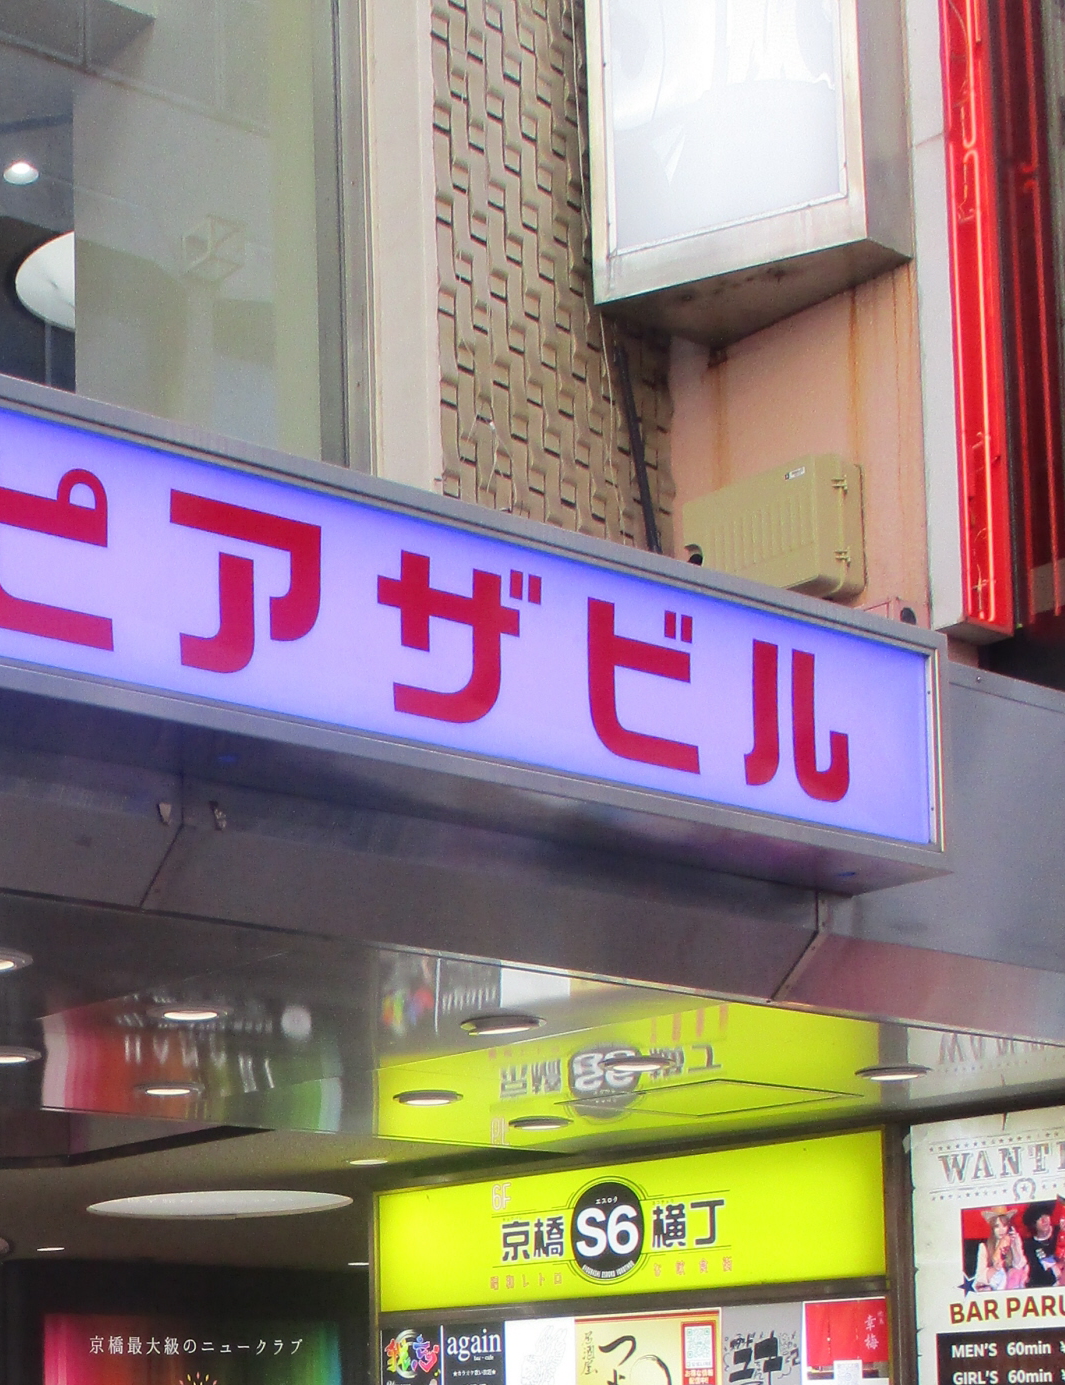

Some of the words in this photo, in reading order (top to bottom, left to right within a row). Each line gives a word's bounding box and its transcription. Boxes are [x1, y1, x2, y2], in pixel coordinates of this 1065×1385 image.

[491, 1183, 512, 1211] 6F
[501, 1215, 565, 1263] 京橋
[575, 1204, 639, 1257] S6
[652, 1198, 725, 1249] 横丁
[949, 1298, 1000, 1325] BAR
[89, 1335, 303, 1356] 京橋最大級のニュークラブ
[446, 1328, 502, 1362] again
[952, 1342, 998, 1359] MEN'S
[1007, 1340, 1052, 1357] 60min
[952, 1369, 999, 1385] GIRL'S
[1008, 1367, 1053, 1384] 60min
